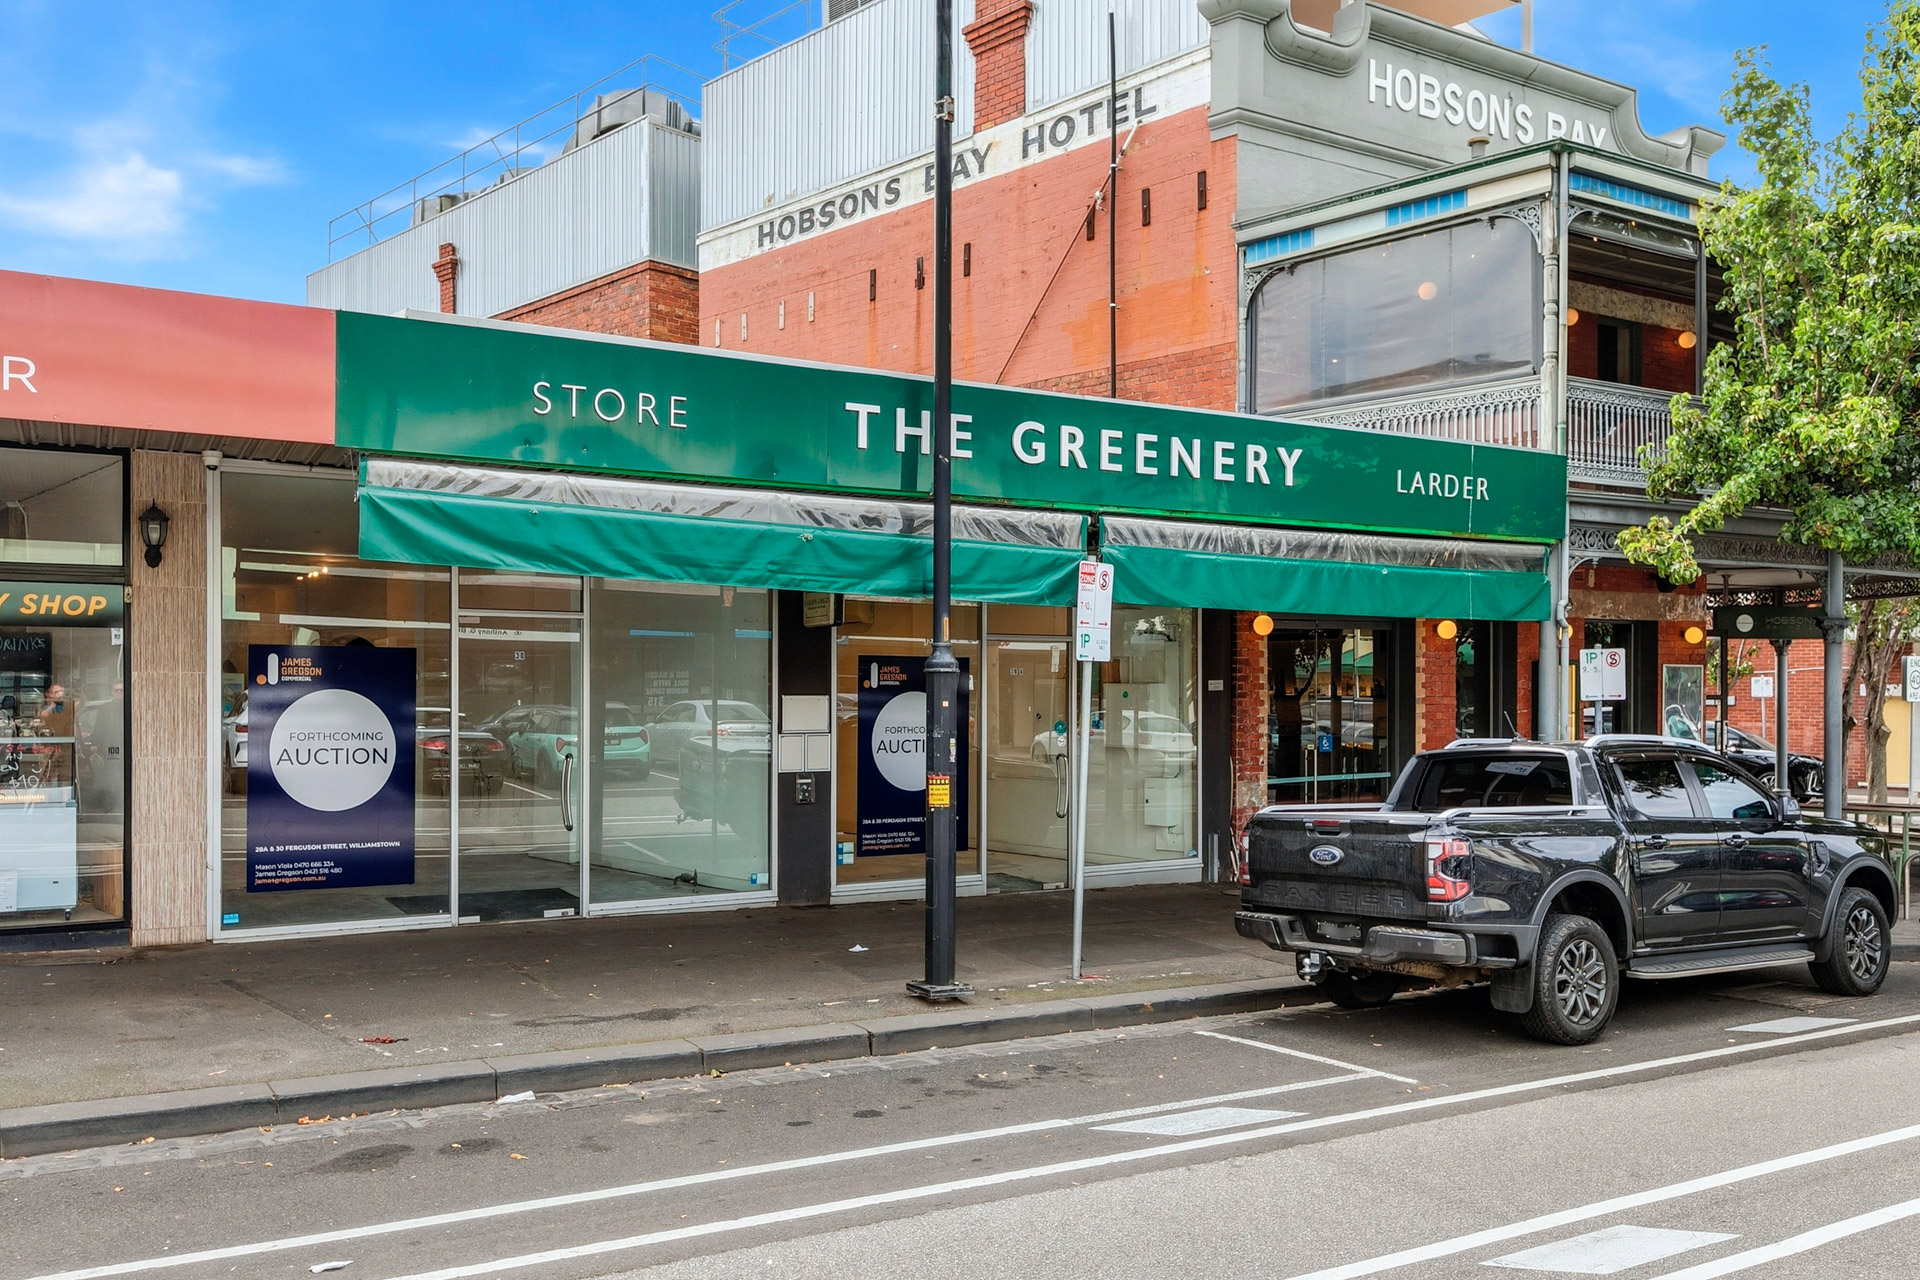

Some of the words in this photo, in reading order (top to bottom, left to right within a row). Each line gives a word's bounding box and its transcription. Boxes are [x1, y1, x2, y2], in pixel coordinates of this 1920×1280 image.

[1368, 58, 1535, 145] HOBSON'S
[1546, 111, 1607, 149] BAY
[757, 178, 901, 248] HOBSONS
[1021, 87, 1158, 159] HOTEL
[3, 355, 38, 393] R
[532, 381, 688, 428] STORE
[843, 401, 973, 460] THE
[1010, 420, 1304, 487] GREENERY
[1396, 469, 1490, 501] LARDER
[19, 593, 108, 617] SHOP
[1080, 633, 1091, 649] 1P
[281, 658, 312, 667] JAMES
[1585, 652, 1598, 664] 1P
[281, 666, 322, 676] GREGSON
[880, 673, 907, 681] GREGSON
[289, 732, 384, 742] FORTHCOMING
[885, 726, 926, 735] FORTHCO
[876, 738, 926, 754] AUCTI
[276, 747, 388, 766] AUCTION
[275, 844, 285, 852] 30
[285, 843, 322, 852] FERGUSON
[322, 842, 349, 850] STREET,
[348, 841, 401, 849] WILLIAMSTOWN
[255, 870, 276, 878] James
[276, 869, 304, 877] Gregson
